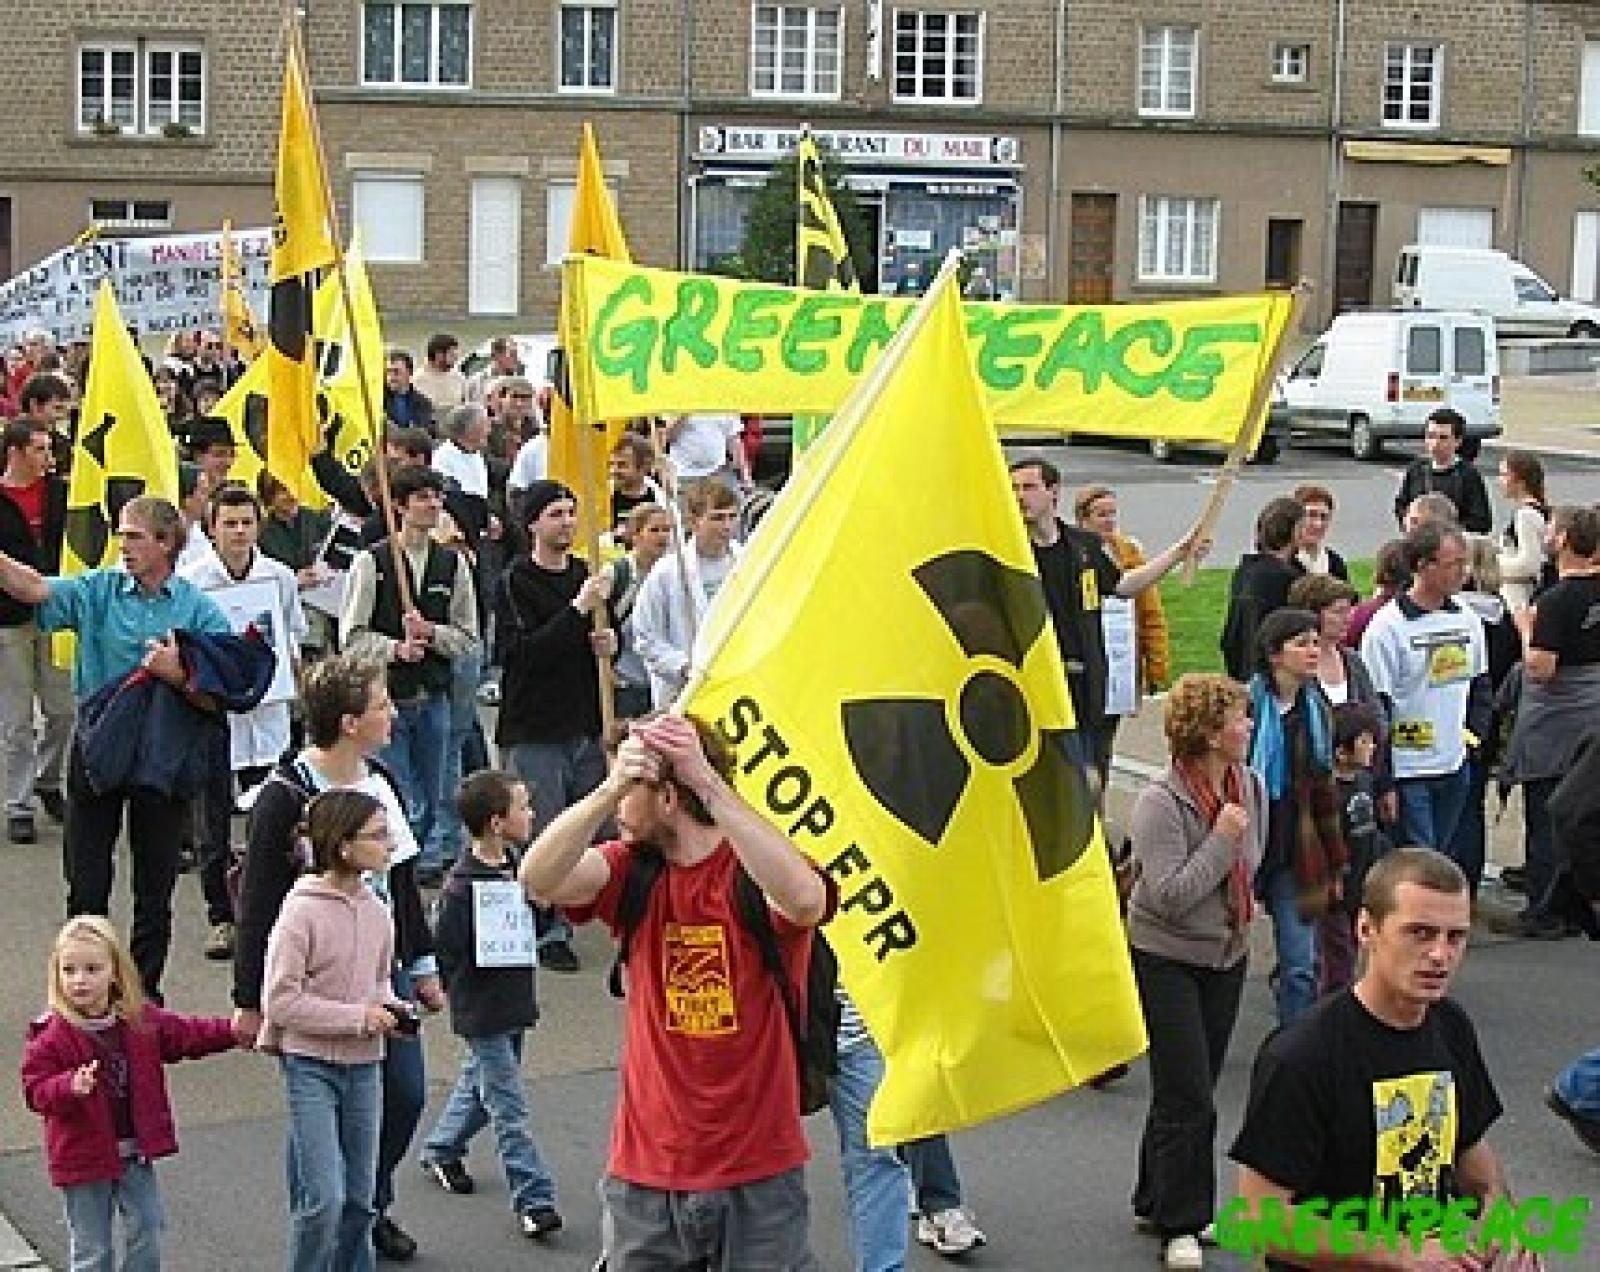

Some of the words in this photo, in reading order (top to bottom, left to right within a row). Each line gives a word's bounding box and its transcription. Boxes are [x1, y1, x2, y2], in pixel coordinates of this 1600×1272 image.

[728, 132, 765, 150] BAR
[777, 134, 889, 155] REURANT
[903, 137, 930, 156] DU
[715, 695, 834, 838] STOP
